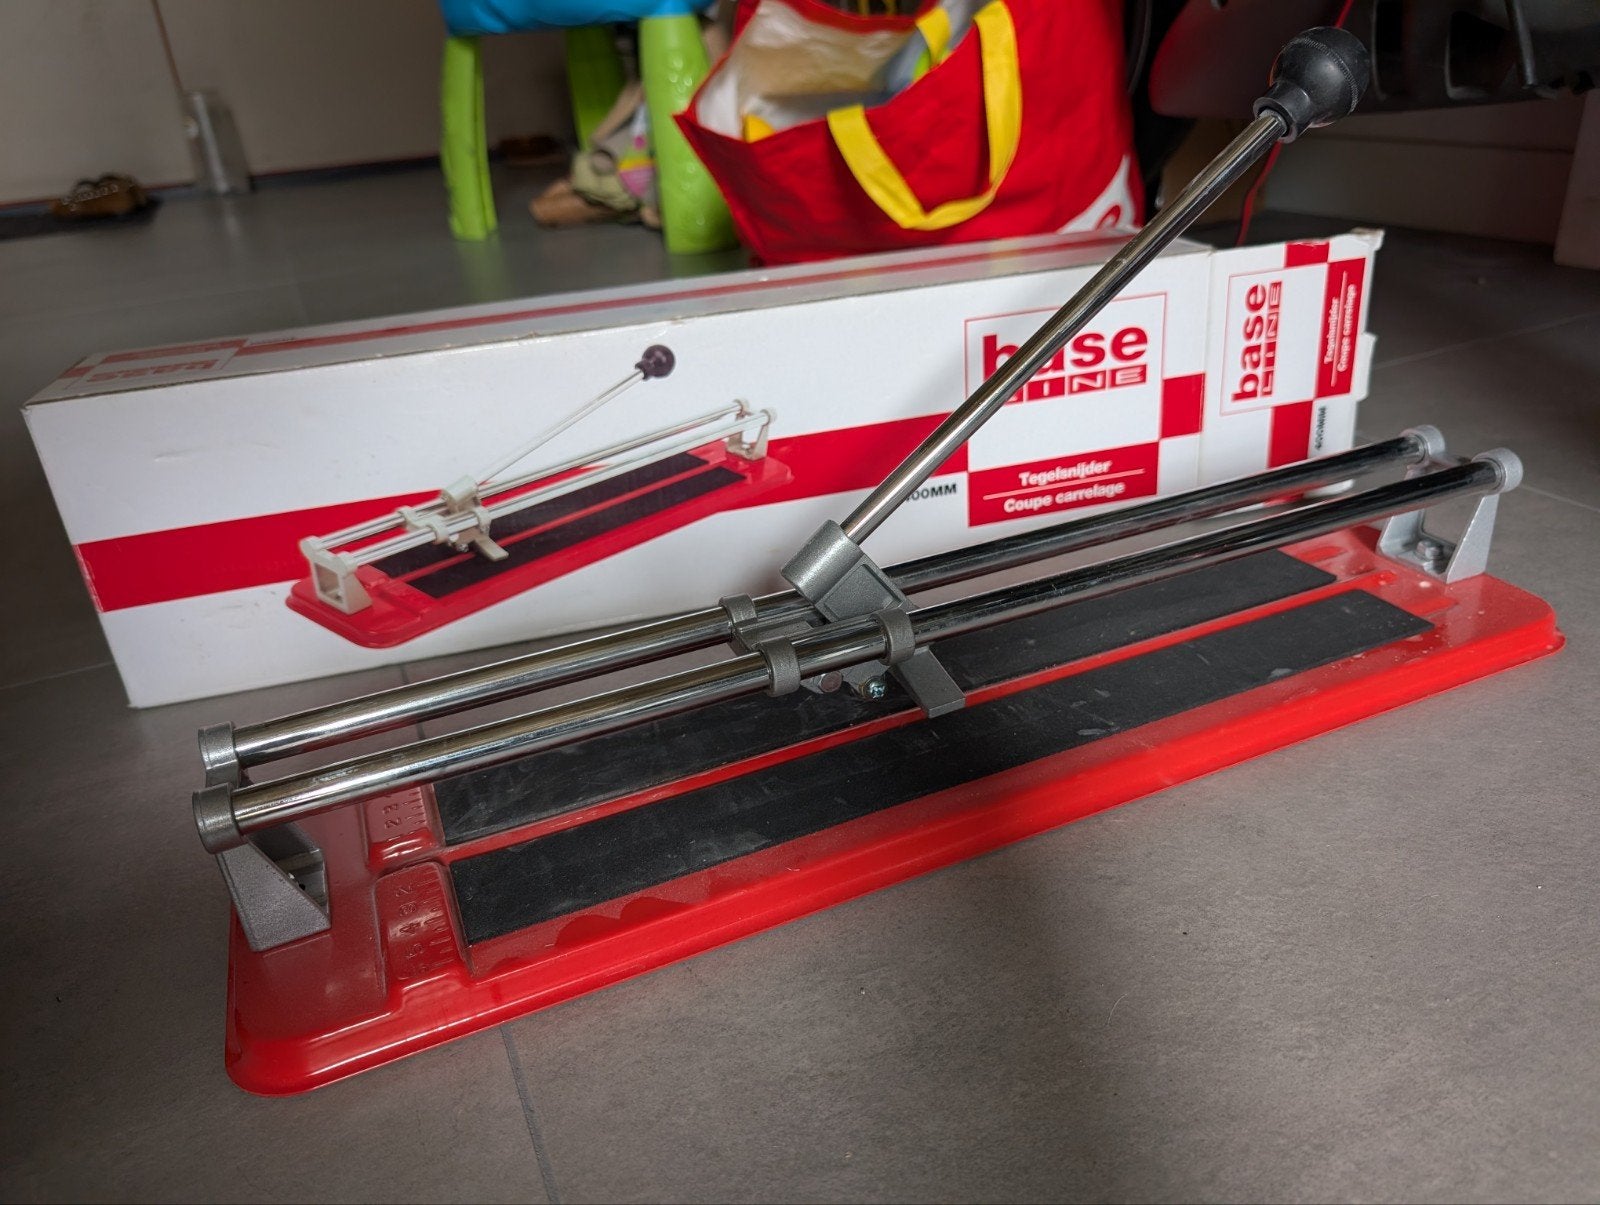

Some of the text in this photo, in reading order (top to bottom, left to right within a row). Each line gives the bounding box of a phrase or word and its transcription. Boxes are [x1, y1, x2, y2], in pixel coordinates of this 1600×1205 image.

[1231, 284, 1267, 401] base
[1262, 281, 1282, 396] LINE
[1004, 364, 1148, 406] INE
[1019, 460, 1113, 487] Tegelsnijder
[905, 483, 957, 502] 00MM
[1003, 481, 1126, 514] Coupe carrelage
